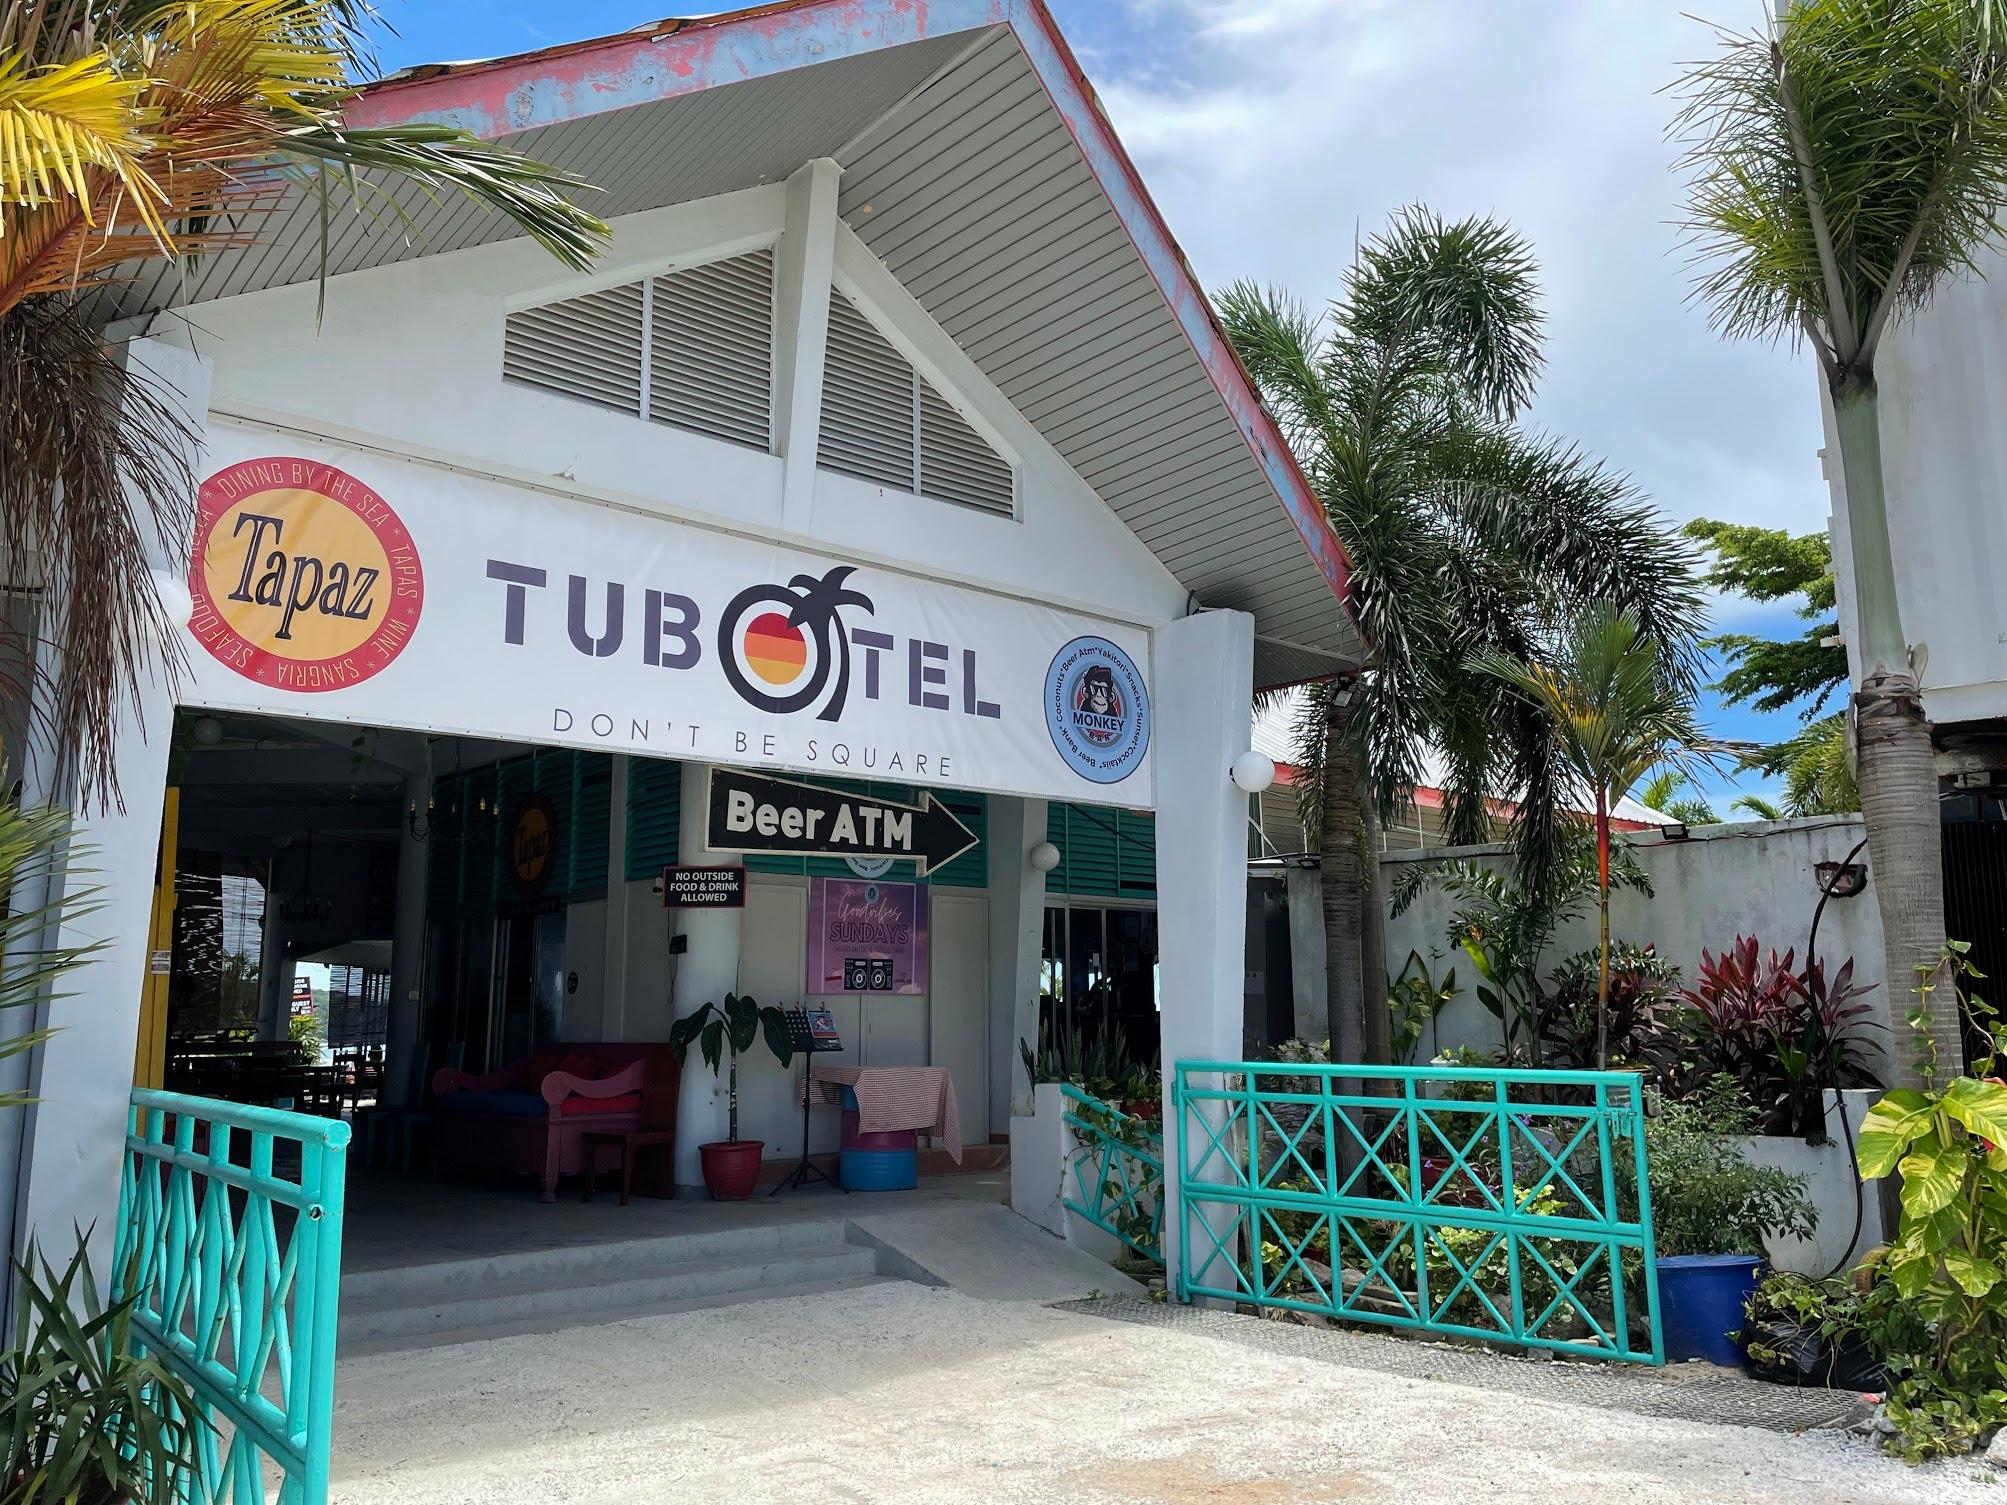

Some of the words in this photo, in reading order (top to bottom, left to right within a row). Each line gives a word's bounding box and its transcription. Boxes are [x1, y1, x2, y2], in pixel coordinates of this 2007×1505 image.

[217, 462, 284, 499] DINING
[292, 463, 315, 485] BY
[323, 470, 360, 501] THE
[356, 494, 390, 528] SEA
[227, 512, 380, 640] Tapaz
[390, 543, 418, 599] TAPAS
[371, 617, 410, 660] WINE
[277, 658, 360, 687] SANGRIA
[1073, 711, 1125, 732] MONKEY
[553, 708, 701, 748] DON'T
[736, 731, 776, 757] BE
[806, 739, 951, 777] SQUARE
[726, 789, 825, 840] Beer
[829, 804, 913, 851] ATM
[670, 882, 697, 892] FOOD
[699, 882, 707, 892] &
[708, 882, 739, 892] DRINK
[675, 871, 690, 881] NO
[692, 871, 734, 881] OUTSIDE
[680, 892, 727, 902] ALLOWED
[830, 922, 909, 944] SUNDAYS
